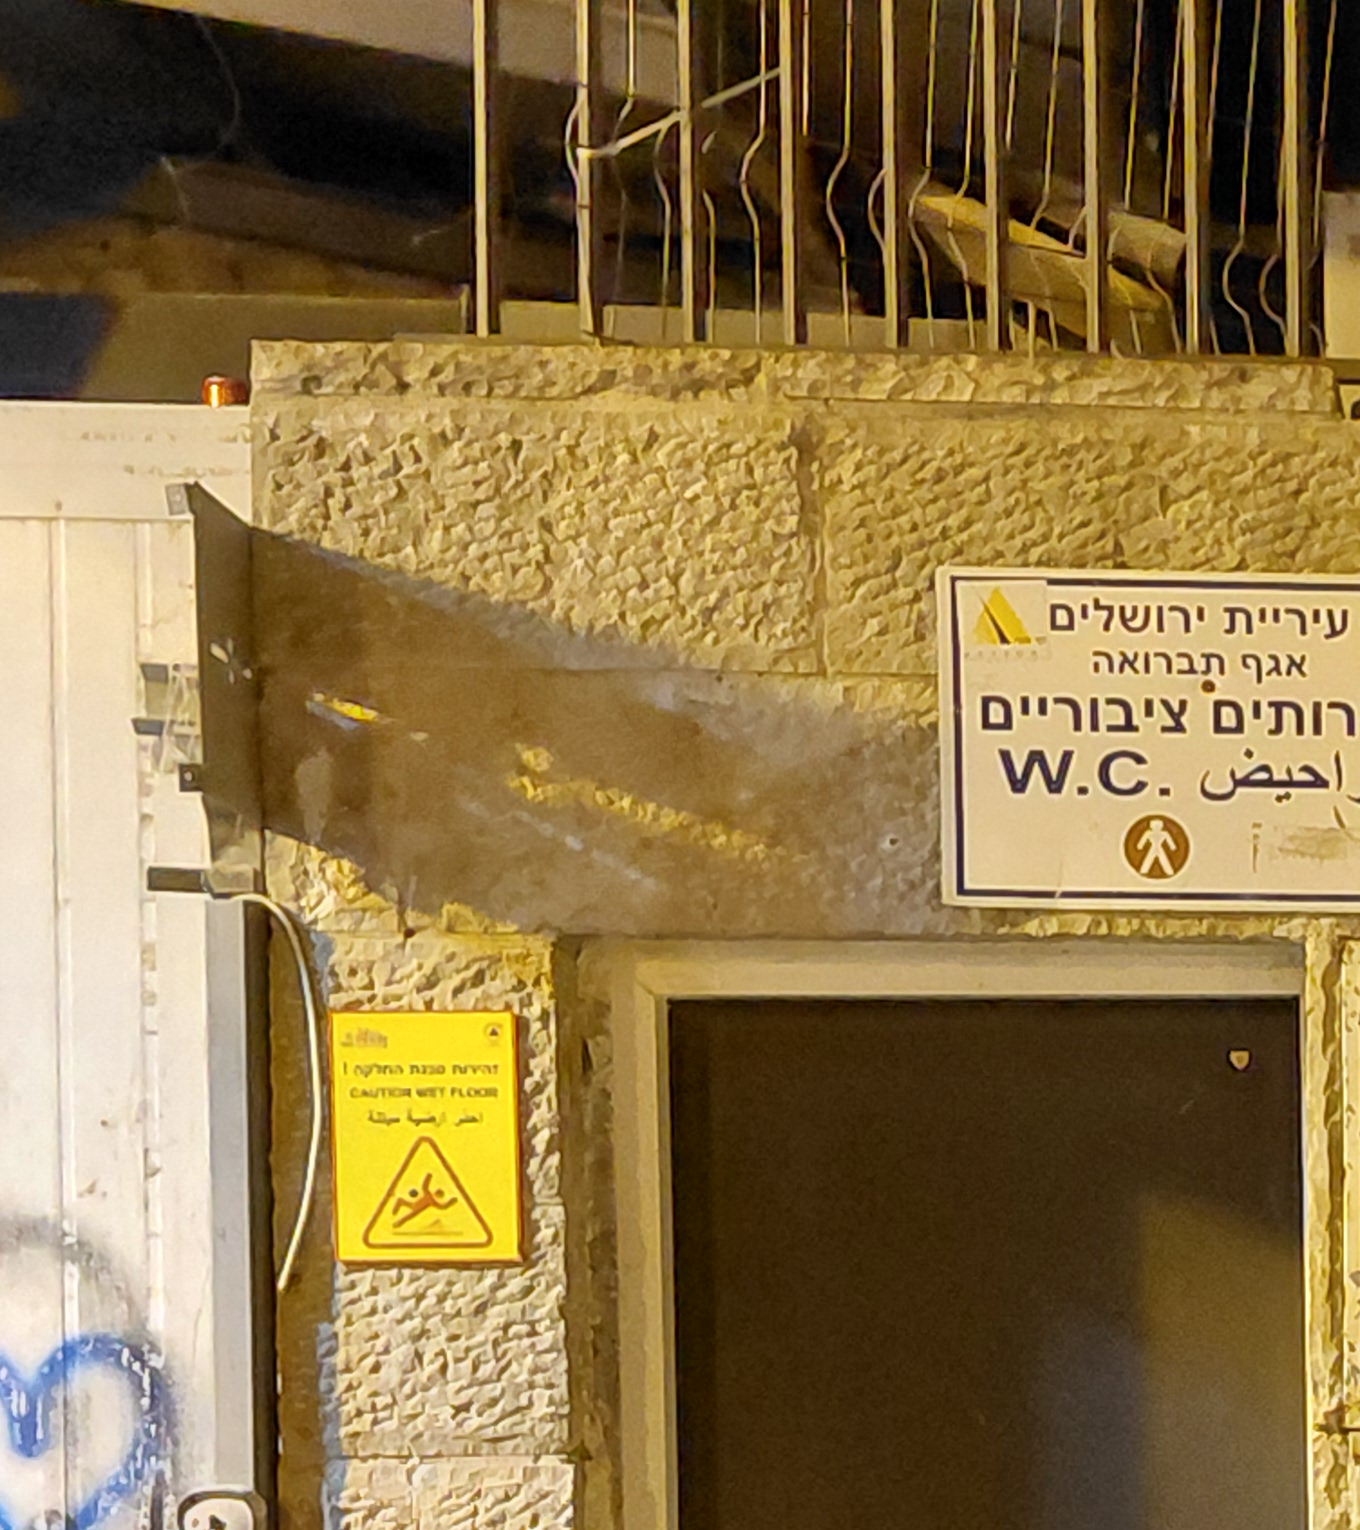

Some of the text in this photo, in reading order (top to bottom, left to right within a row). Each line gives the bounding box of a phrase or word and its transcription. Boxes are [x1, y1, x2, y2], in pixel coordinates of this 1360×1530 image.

[1050, 598, 1349, 640] עיריית ירושלים
[1093, 651, 1307, 685] אגף תברואה
[981, 696, 1188, 735] ציבוריים
[998, 749, 1171, 797] W.C.
